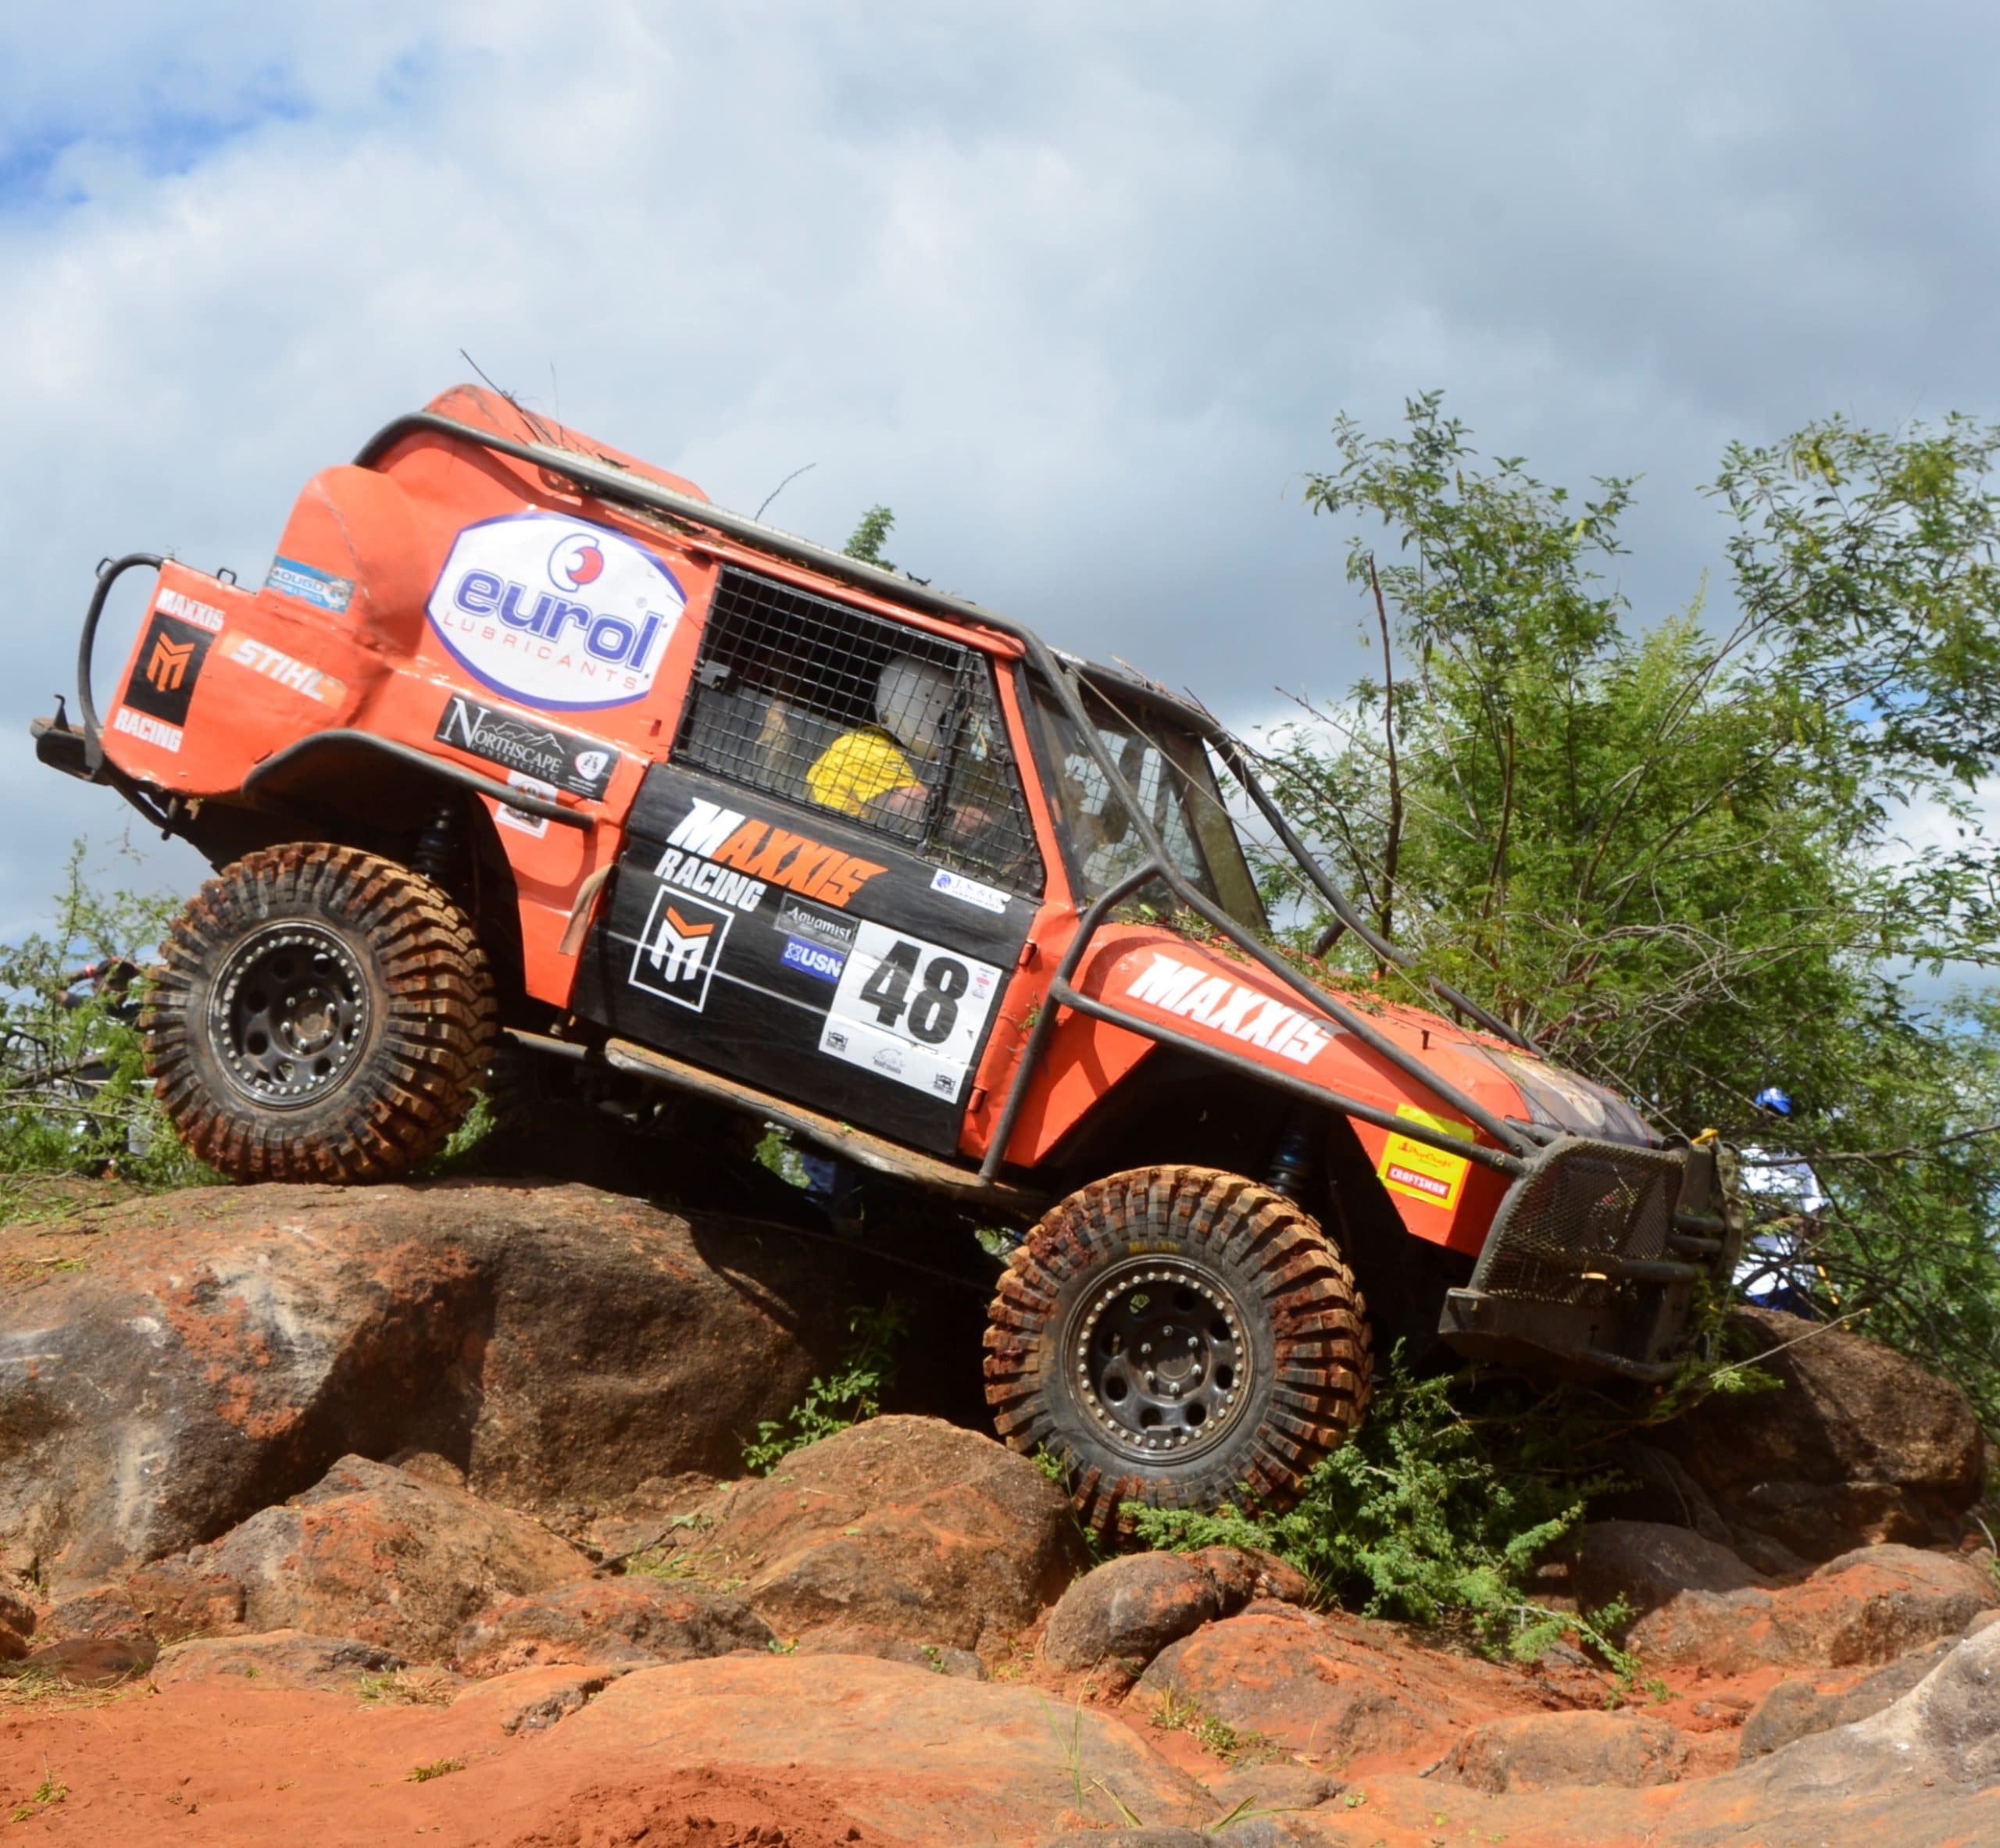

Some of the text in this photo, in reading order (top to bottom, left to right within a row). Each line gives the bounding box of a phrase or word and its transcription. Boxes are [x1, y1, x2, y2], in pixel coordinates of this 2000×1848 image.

[155, 587, 226, 632] MAXXIS
[454, 568, 664, 672] eurol
[233, 640, 324, 701] STIHL
[442, 612, 638, 690] LUBRICANTS
[113, 708, 184, 753] RACING
[438, 697, 563, 774] NORTHSCAPE
[471, 742, 557, 782] CONTRACTING
[653, 847, 766, 913] RACING
[666, 797, 888, 907] MAXXIS
[786, 906, 852, 941] Aquamist
[800, 947, 843, 978] USN
[859, 939, 970, 1046] 48
[1127, 951, 1350, 1065] MAXXIS
[1390, 1167, 1447, 1196] CRAFTSMAN
